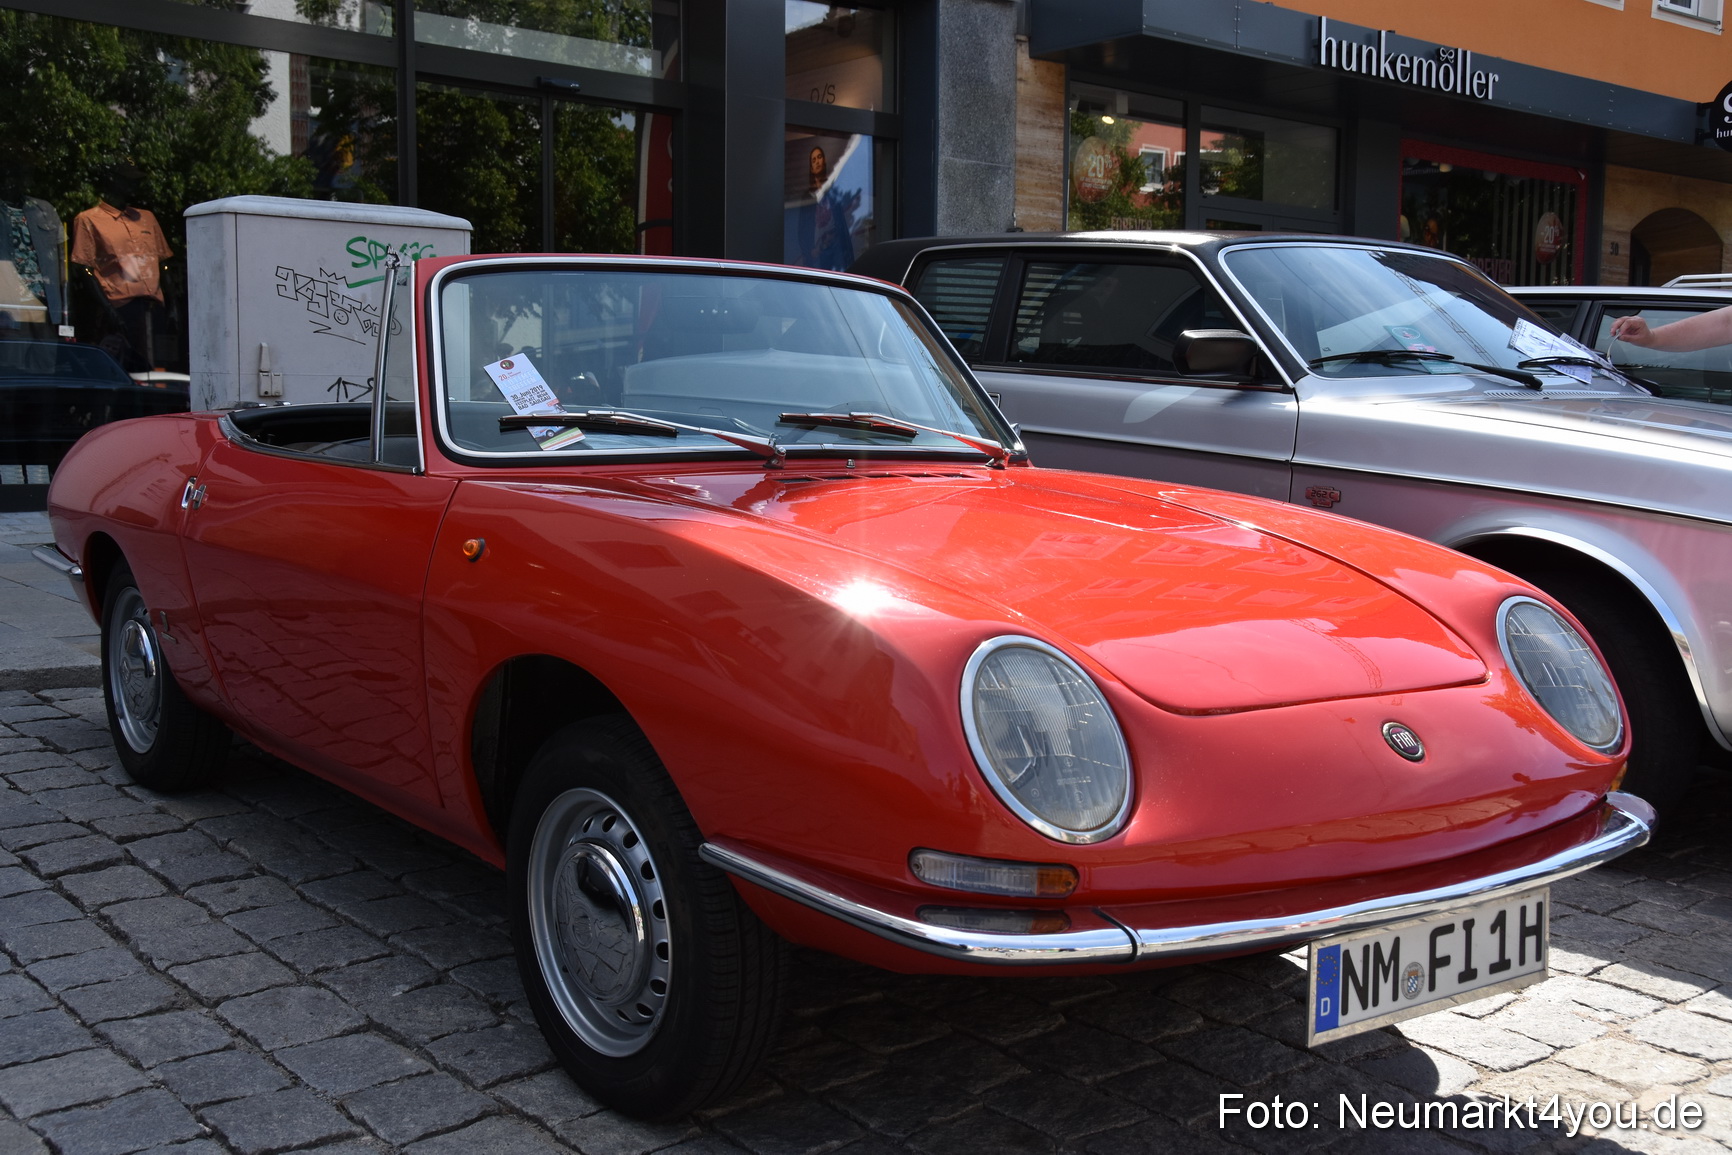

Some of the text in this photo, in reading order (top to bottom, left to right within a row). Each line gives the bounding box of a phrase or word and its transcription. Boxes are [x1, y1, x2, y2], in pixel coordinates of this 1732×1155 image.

[1320, 16, 1499, 100] hunkemöller
[1392, 731, 1417, 749] FIAT
[1341, 936, 1400, 1016] NM
[1320, 997, 1331, 1017] D
